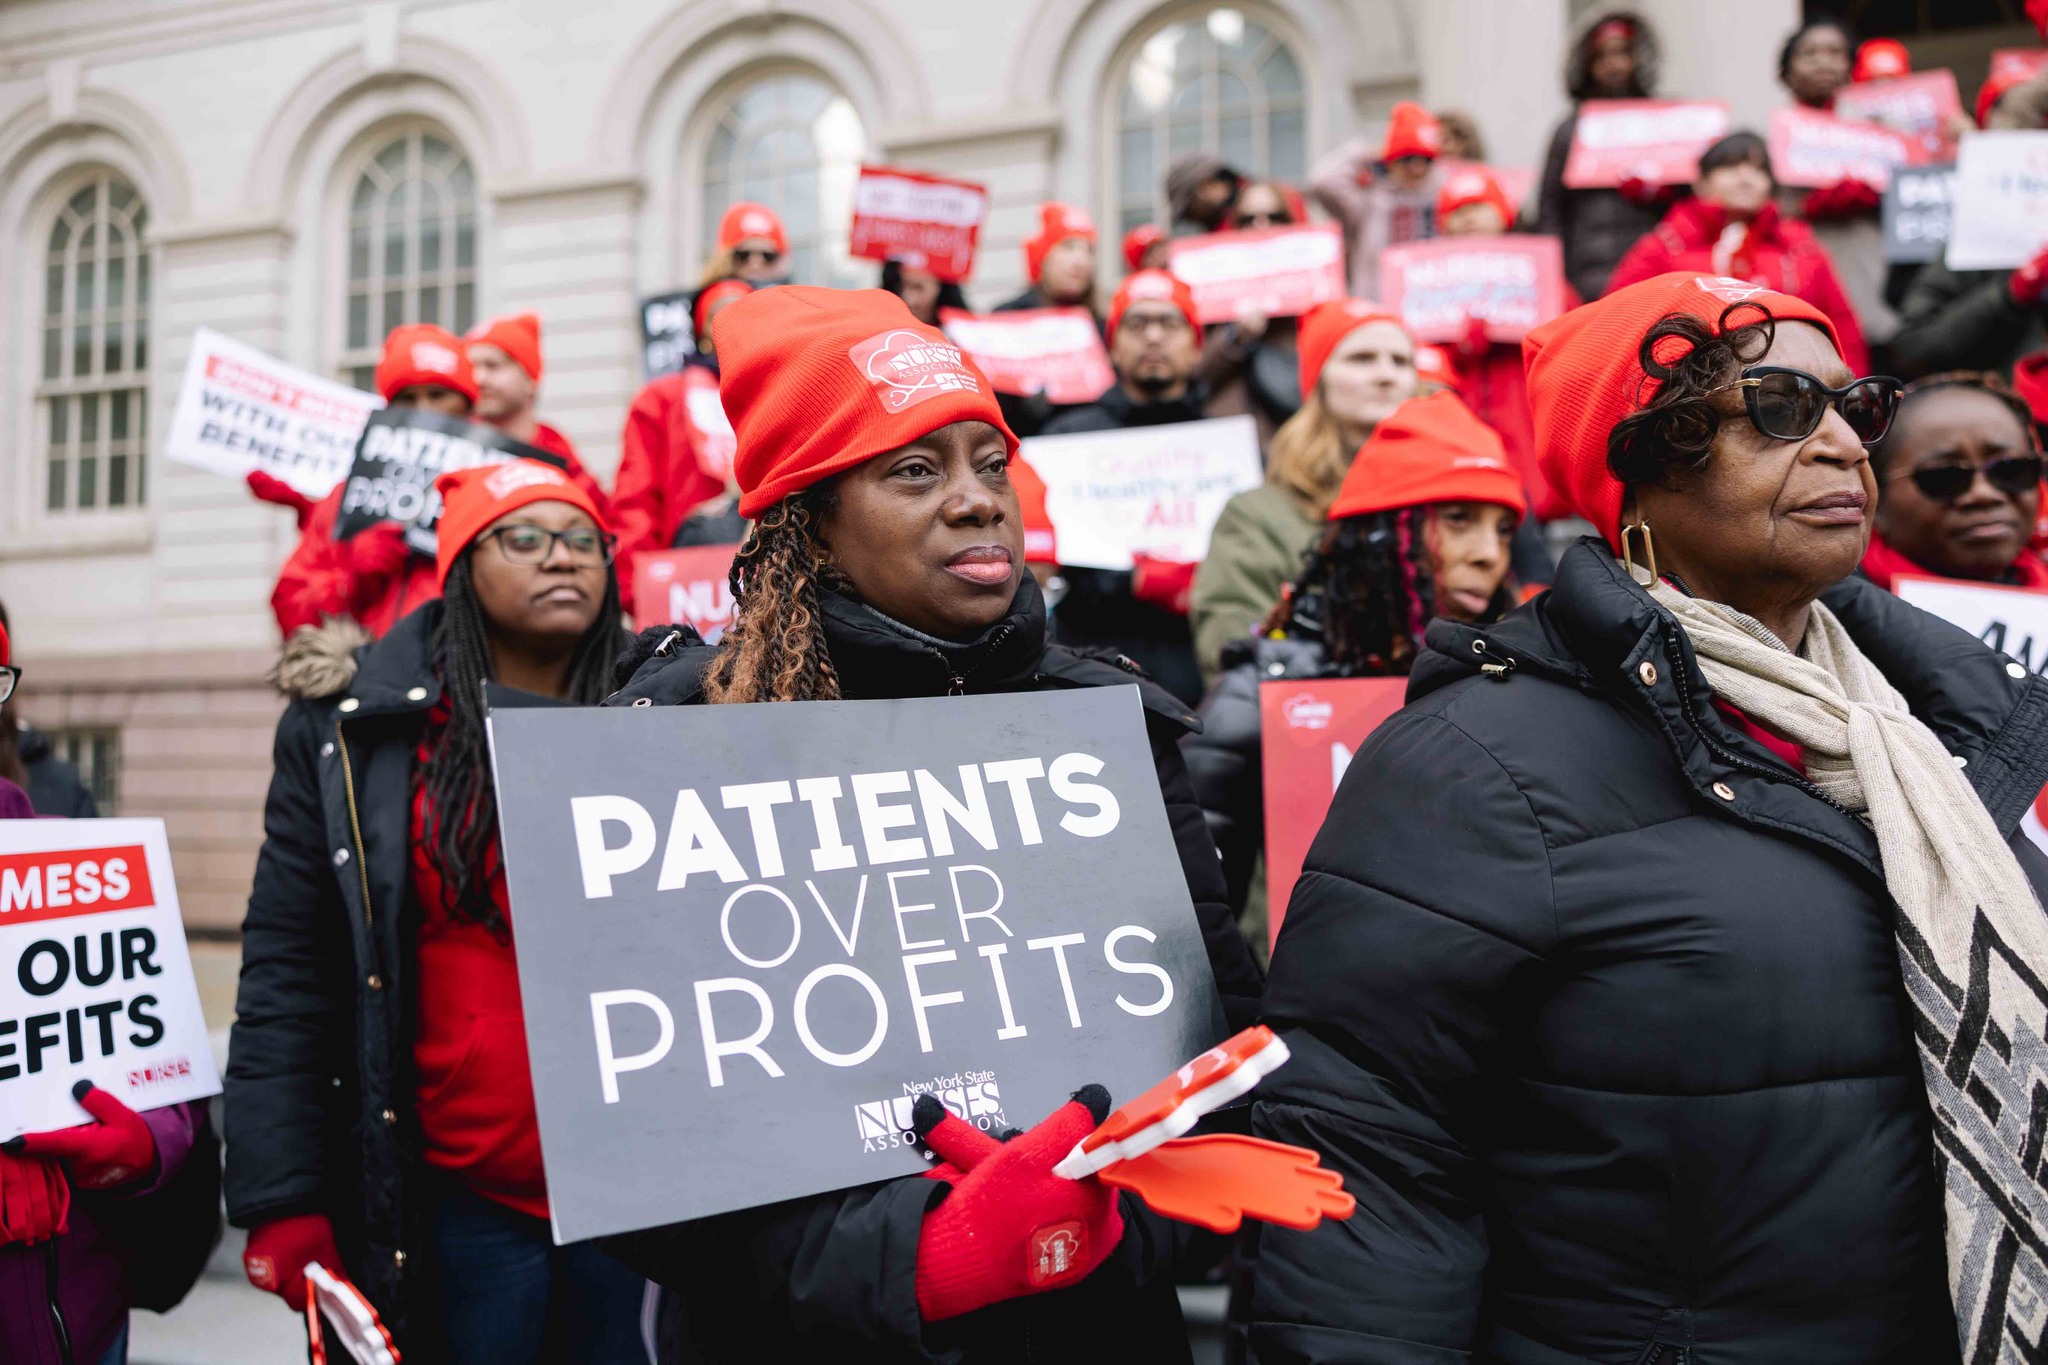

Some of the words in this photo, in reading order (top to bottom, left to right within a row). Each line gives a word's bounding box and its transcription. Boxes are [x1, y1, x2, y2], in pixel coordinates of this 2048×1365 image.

[202, 389, 288, 432] WITH
[342, 476, 444, 528] PROF
[570, 752, 1121, 899] PATIENTS
[0, 857, 131, 913] MESS
[720, 864, 1014, 969] OVER
[17, 927, 163, 996] OUR
[590, 925, 1174, 1104] PROFITS
[854, 1080, 1003, 1140] NUSES
[903, 1081, 934, 1096] New
[934, 1073, 965, 1091] York
[965, 1069, 996, 1084] State
[863, 1112, 1008, 1154] ASSOON
